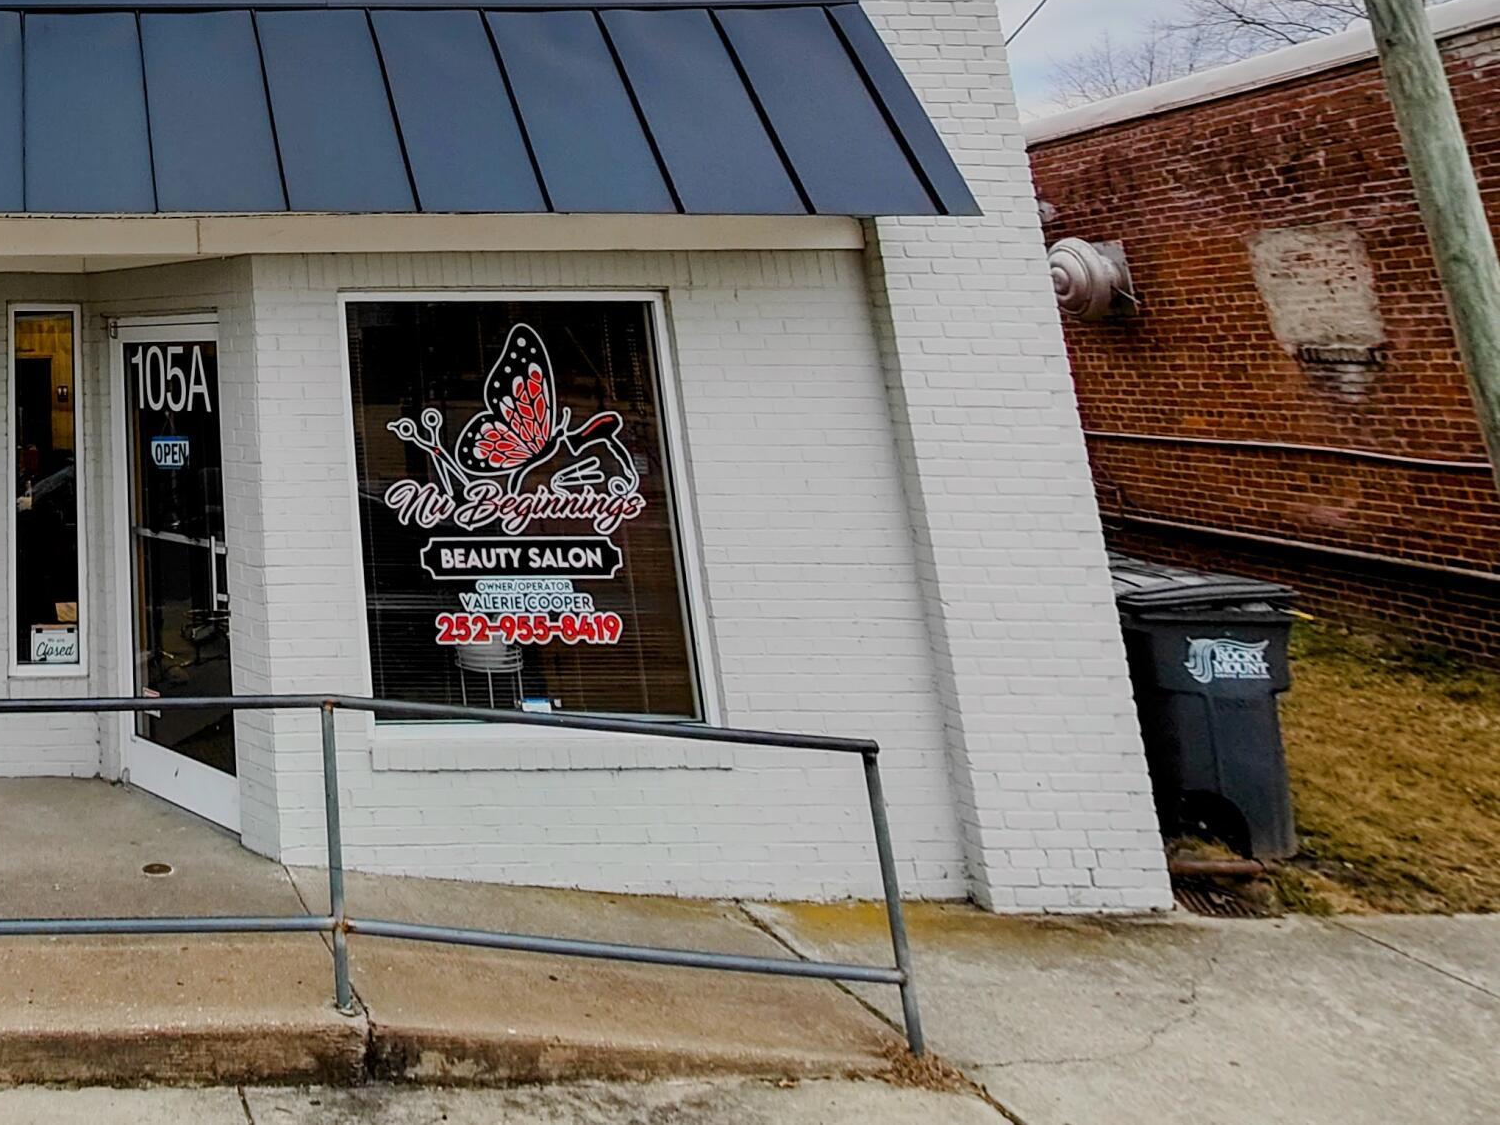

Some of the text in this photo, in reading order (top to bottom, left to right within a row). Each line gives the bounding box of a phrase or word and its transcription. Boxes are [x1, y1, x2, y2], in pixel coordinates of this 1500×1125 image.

[131, 345, 212, 413] 105A
[155, 442, 188, 464] OPEN
[385, 479, 647, 535] Nu Beginnings
[440, 547, 604, 569] BEAUTY SALON
[476, 580, 573, 593] OWNER/OPERATOR
[460, 594, 593, 611] VALERIE COOPER
[437, 614, 621, 643] 252-955-8419
[36, 641, 75, 657] Closed
[1215, 647, 1265, 662] ROCKY
[1213, 661, 1270, 675] MOUNT
